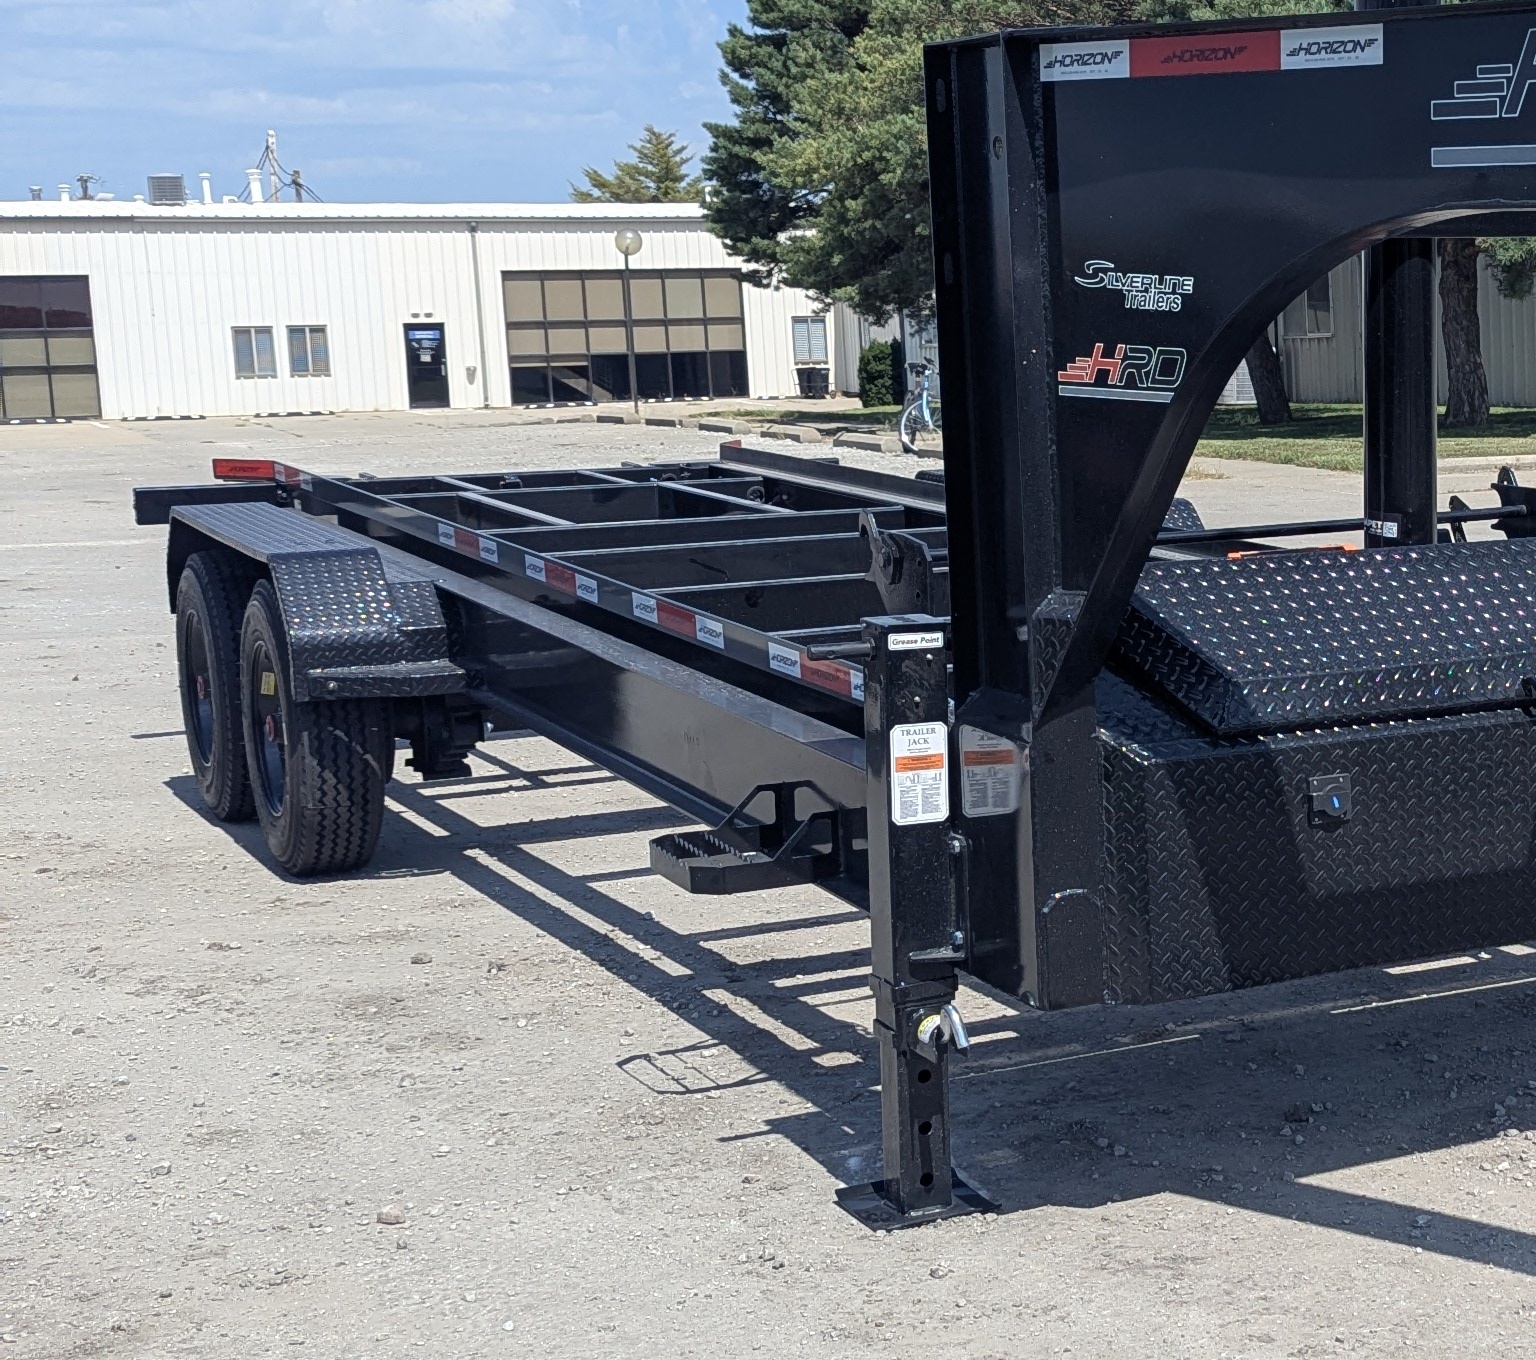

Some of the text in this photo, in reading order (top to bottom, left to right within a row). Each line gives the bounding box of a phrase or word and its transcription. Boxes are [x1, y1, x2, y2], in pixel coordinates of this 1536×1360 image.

[1297, 38, 1368, 57] HORIZON
[1052, 51, 1115, 69] HORIZON
[1074, 260, 1195, 294] SILVERLINE
[1123, 290, 1182, 312] Trailers
[892, 636, 940, 646] Grease Point
[900, 727, 937, 737] TRAILER
[908, 737, 930, 747] JACK
